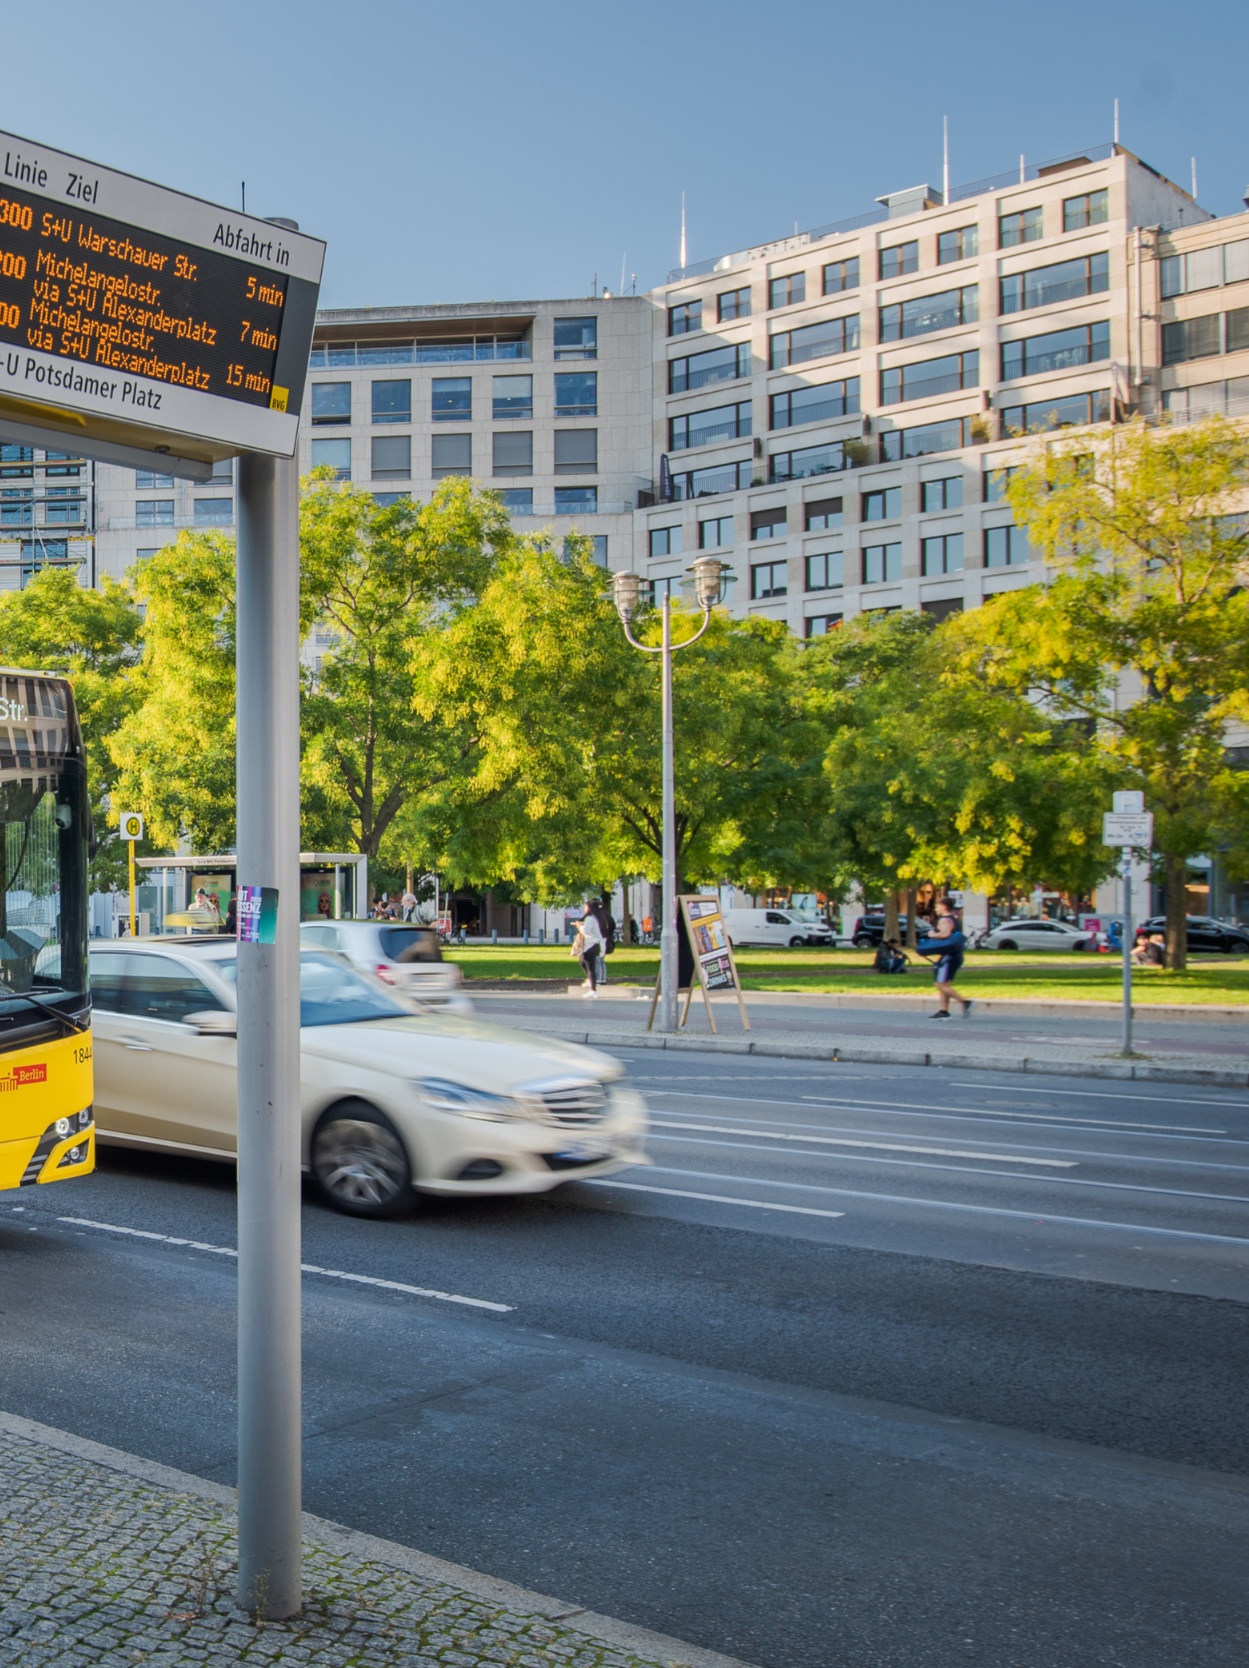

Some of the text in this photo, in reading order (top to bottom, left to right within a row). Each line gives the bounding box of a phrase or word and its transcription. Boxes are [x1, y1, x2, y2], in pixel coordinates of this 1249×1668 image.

[4, 151, 99, 204] Linie Ziel
[40, 212, 72, 243] S+U
[77, 223, 169, 272] Warschauer
[173, 253, 198, 282] Str.
[245, 276, 257, 299] 5
[257, 283, 284, 308] min
[212, 222, 290, 267] Abfahrt in
[35, 248, 162, 307] Michelangelostr.
[29, 297, 155, 353] Michelangelostr.
[33, 276, 278, 351] via S+U Alexanderplatz 7 min
[24, 358, 118, 400] Potsdamer
[121, 380, 163, 411] Platz
[27, 324, 271, 395] via S+U Alexanderplatz 15 min
[271, 398, 285, 411] BVG
[19, 1068, 45, 1082] Berlin
